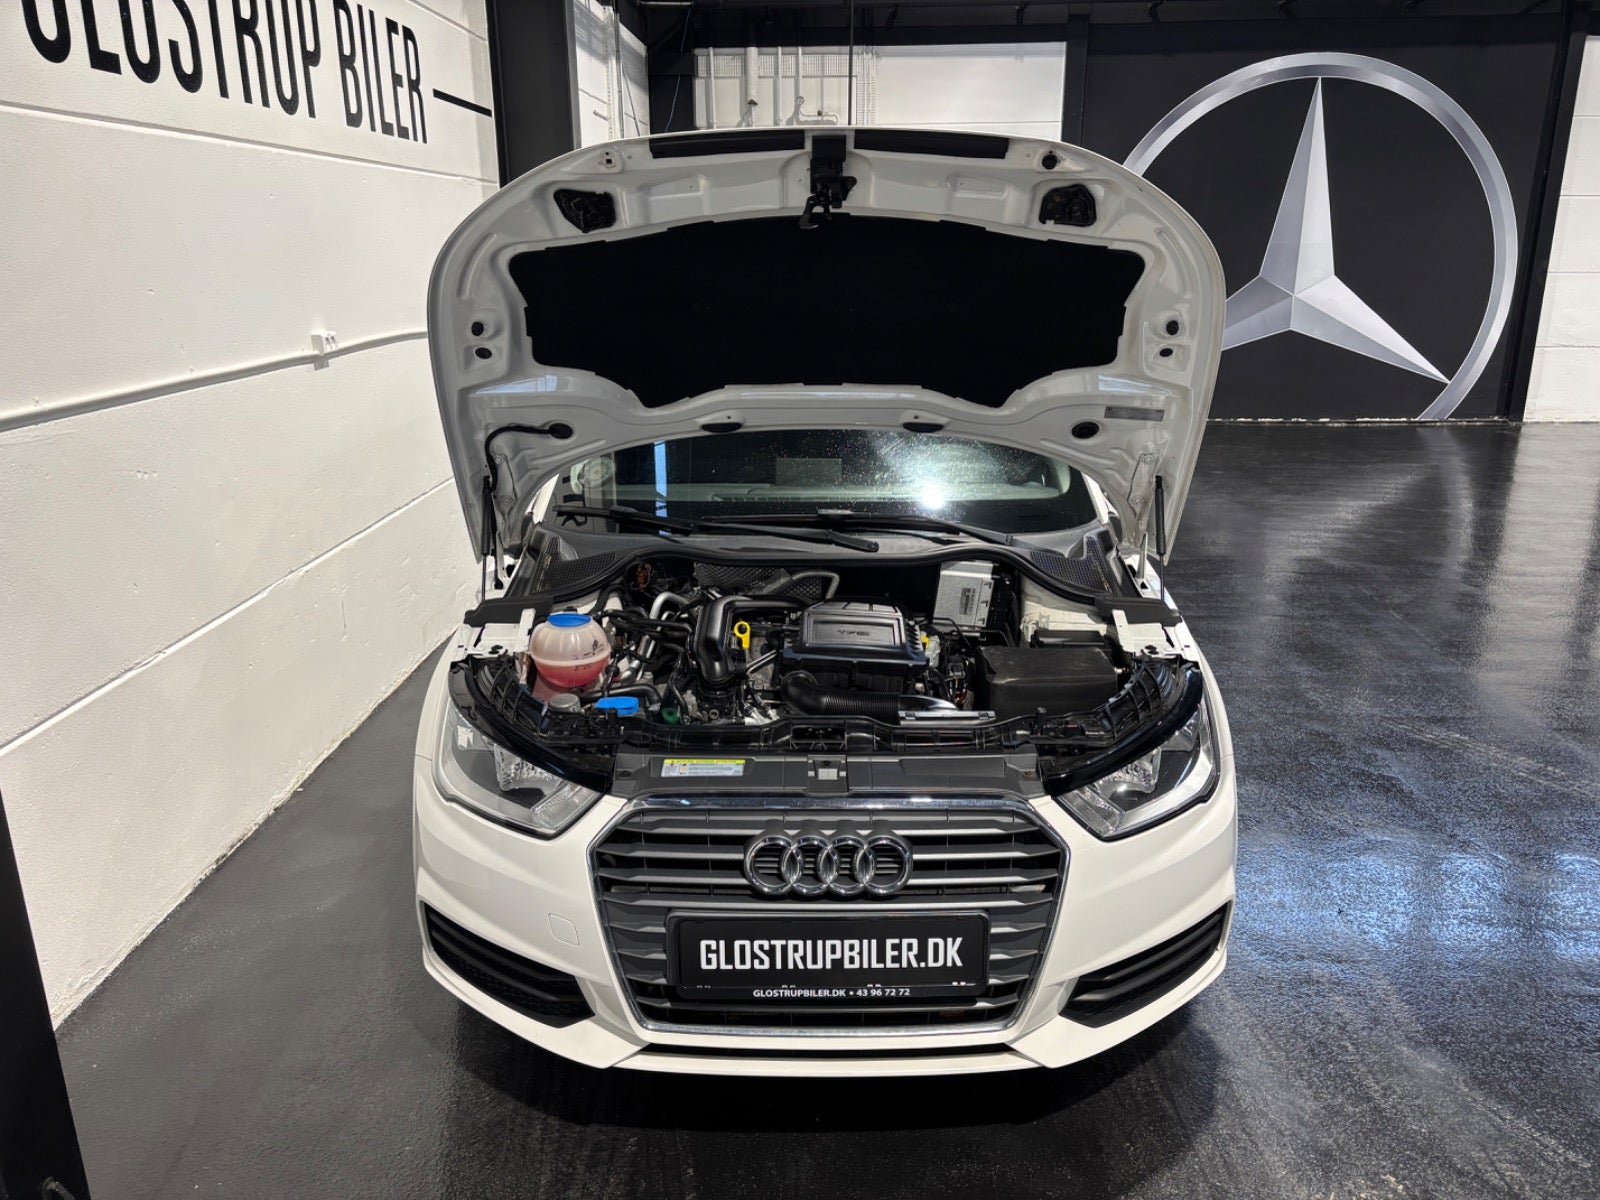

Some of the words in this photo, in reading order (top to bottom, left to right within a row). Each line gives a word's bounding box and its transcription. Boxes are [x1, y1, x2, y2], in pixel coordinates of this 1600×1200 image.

[333, 0, 428, 144] BILER
[699, 937, 963, 970] GLOSTRUPBILER.DK
[752, 988, 846, 998] GLOSTRUPBILER.DK
[856, 988, 869, 997] 43
[870, 987, 883, 997] 96
[884, 986, 896, 996] 72
[898, 986, 911, 996] 72
